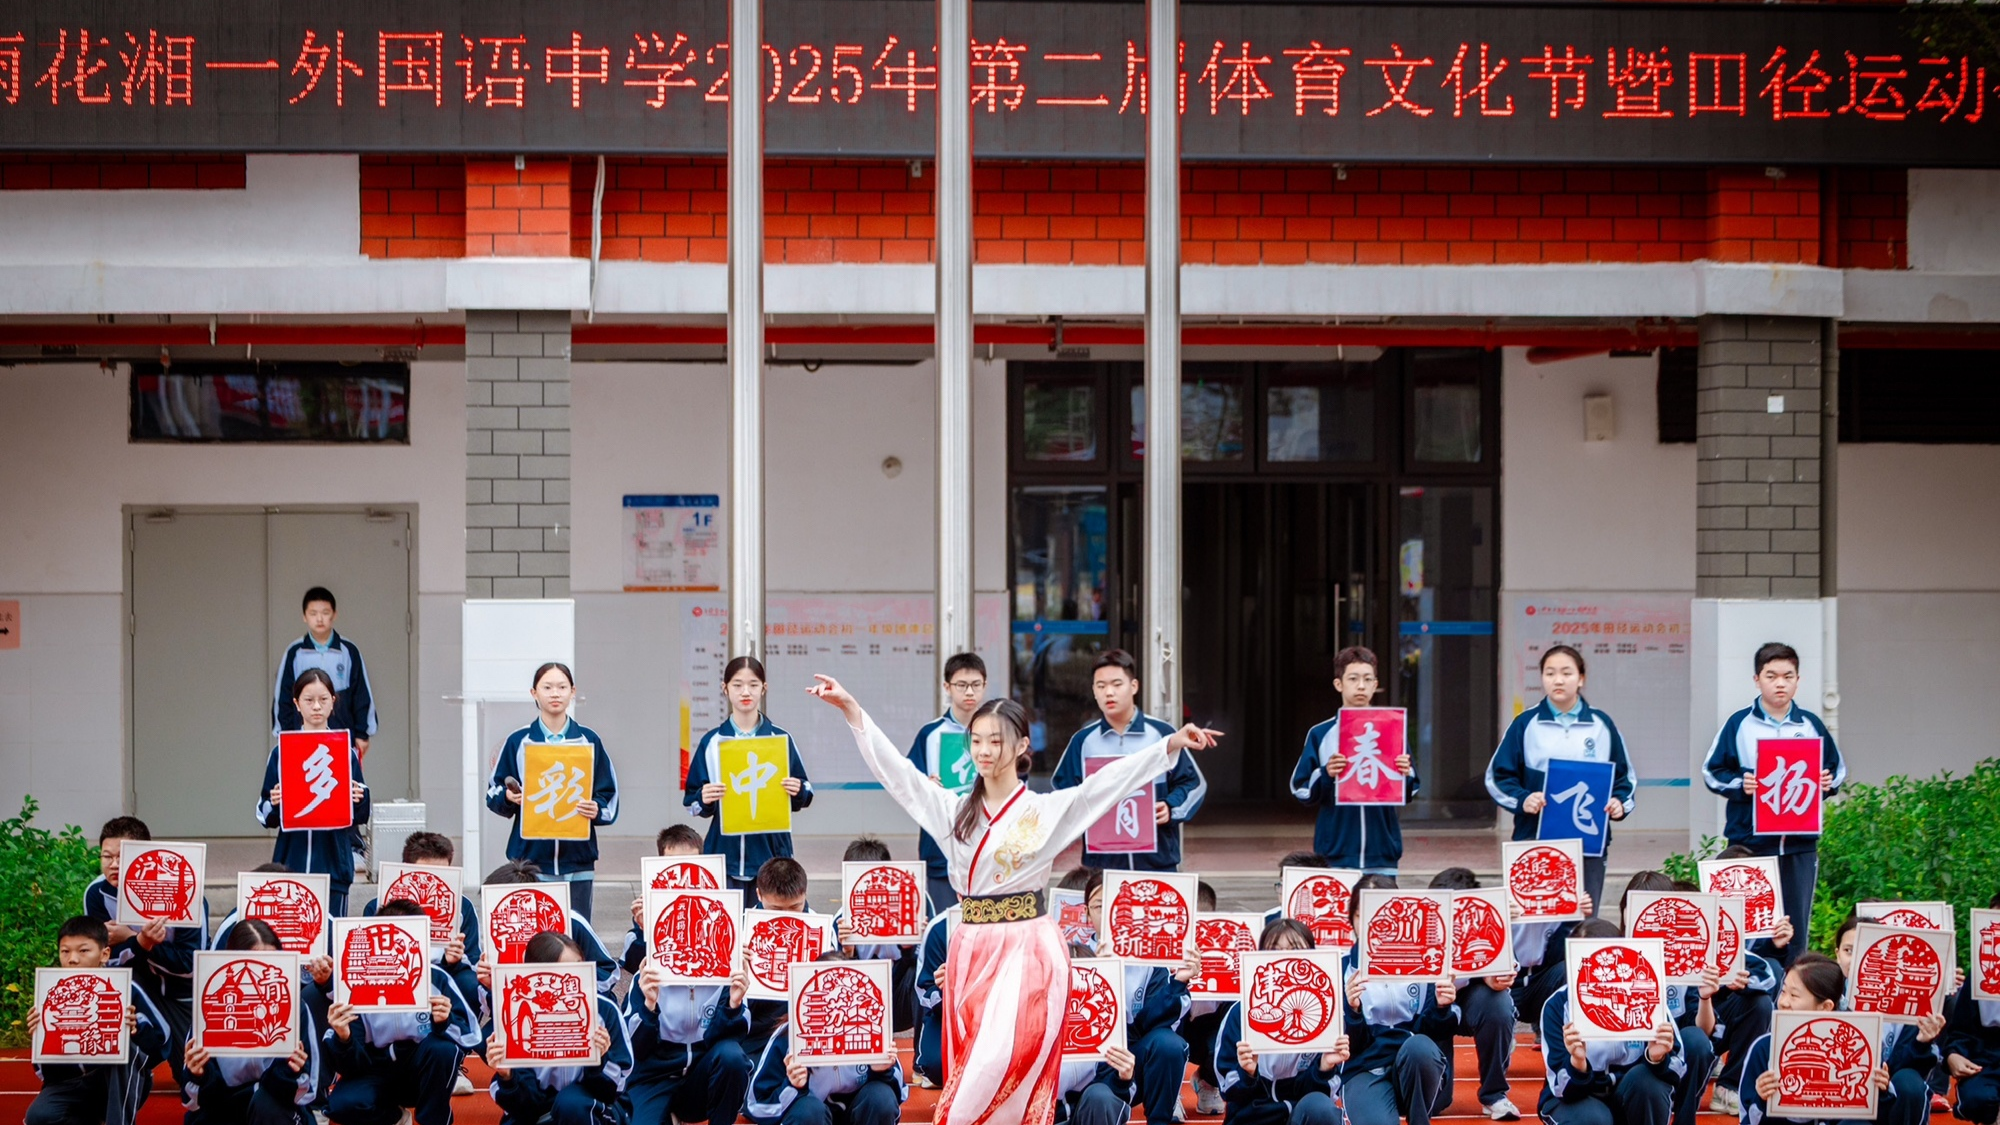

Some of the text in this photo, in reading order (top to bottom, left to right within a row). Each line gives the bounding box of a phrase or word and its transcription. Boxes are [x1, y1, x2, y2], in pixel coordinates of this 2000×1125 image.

[1337, 721, 1403, 790] 春
[294, 743, 339, 818] 多
[526, 761, 587, 822] 彩
[729, 751, 777, 821] 中
[1759, 755, 1817, 816] 扬
[1550, 781, 1600, 836] 飞
[135, 859, 155, 880] 沪
[1531, 857, 1549, 875] 皖
[434, 894, 451, 914] 闽
[1654, 899, 1678, 925] 赣
[1751, 906, 1774, 931] 桂
[371, 924, 398, 952] 甘
[497, 924, 515, 953] 宁
[850, 914, 875, 937] 琼
[653, 935, 682, 967] 鲁
[750, 934, 777, 954] 蒙
[1114, 928, 1142, 956] 新
[259, 964, 289, 1001] 青
[560, 974, 586, 1012] 粤
[1254, 963, 1286, 1003] 津
[825, 996, 850, 1028] 苏
[1624, 1000, 1652, 1030] 藏
[79, 1027, 104, 1055] 豫
[1838, 1068, 1869, 1099] 京
